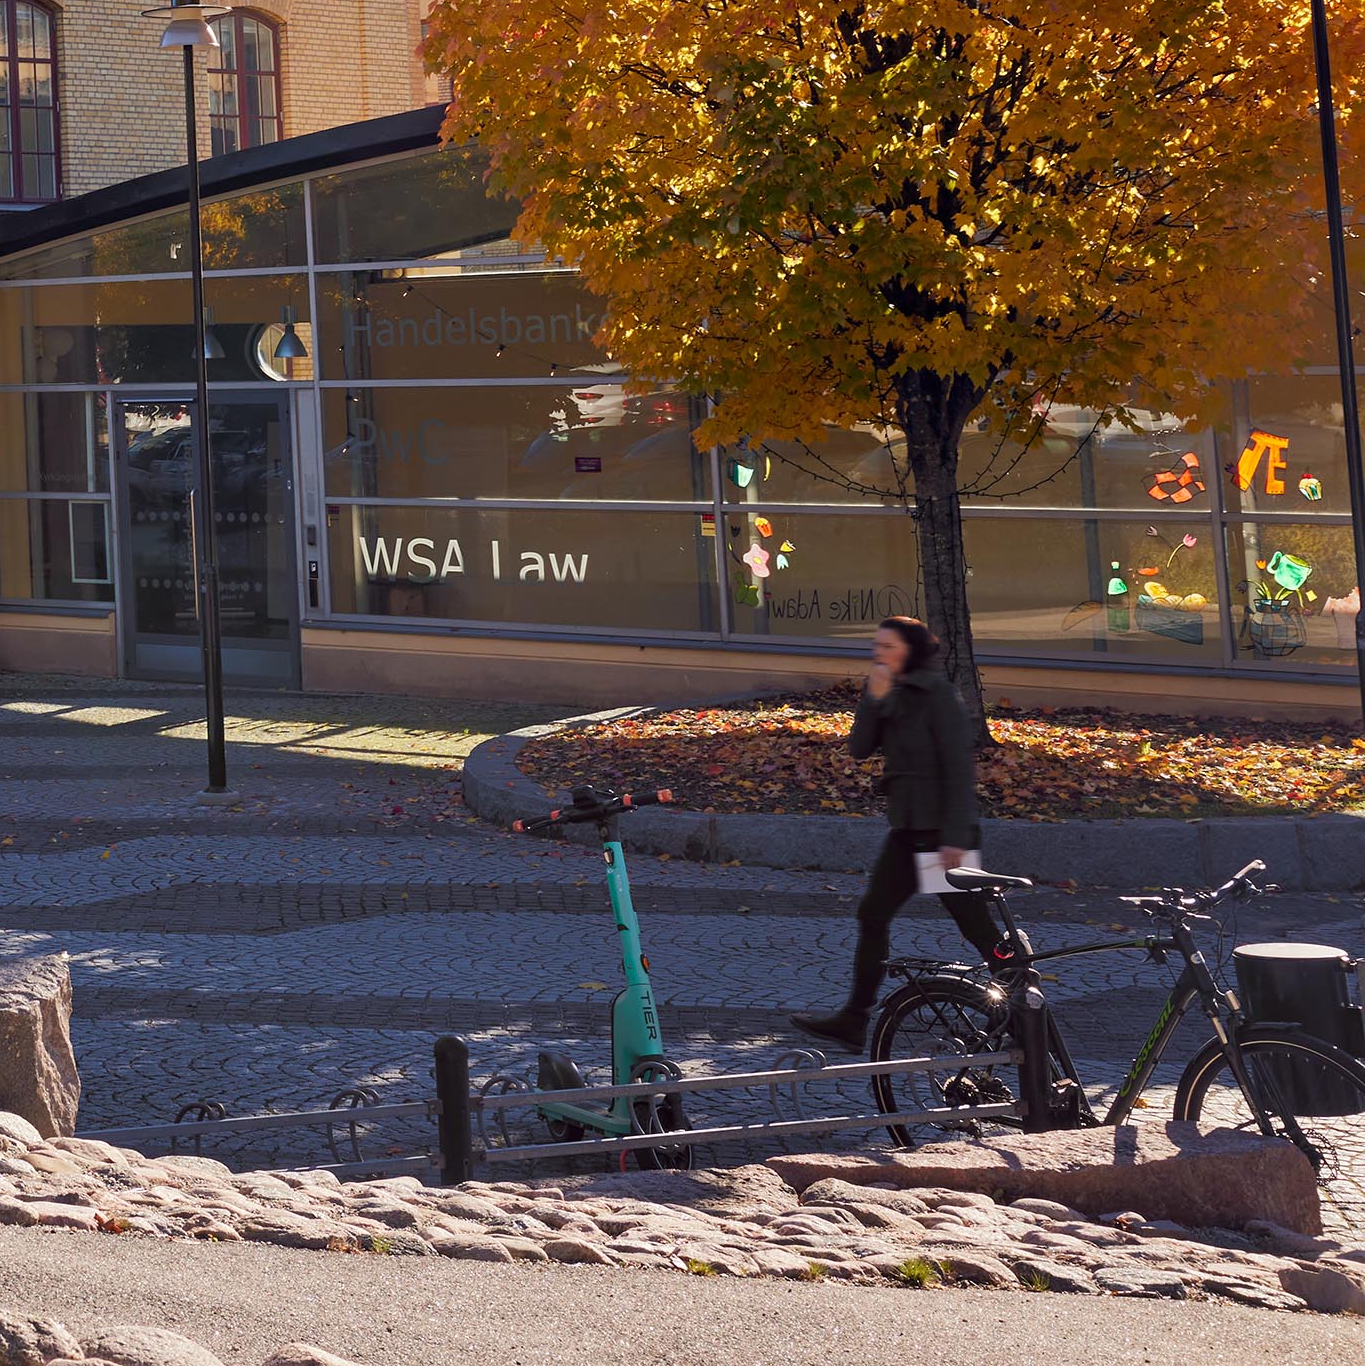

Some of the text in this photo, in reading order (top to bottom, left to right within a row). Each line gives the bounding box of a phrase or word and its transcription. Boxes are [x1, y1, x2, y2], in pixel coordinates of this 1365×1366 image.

[350, 303, 612, 347] Handelsbank
[355, 417, 450, 467] PwC
[359, 536, 466, 584] WSA
[641, 991, 658, 1041] TIER
[1120, 991, 1175, 1097] Crescent
